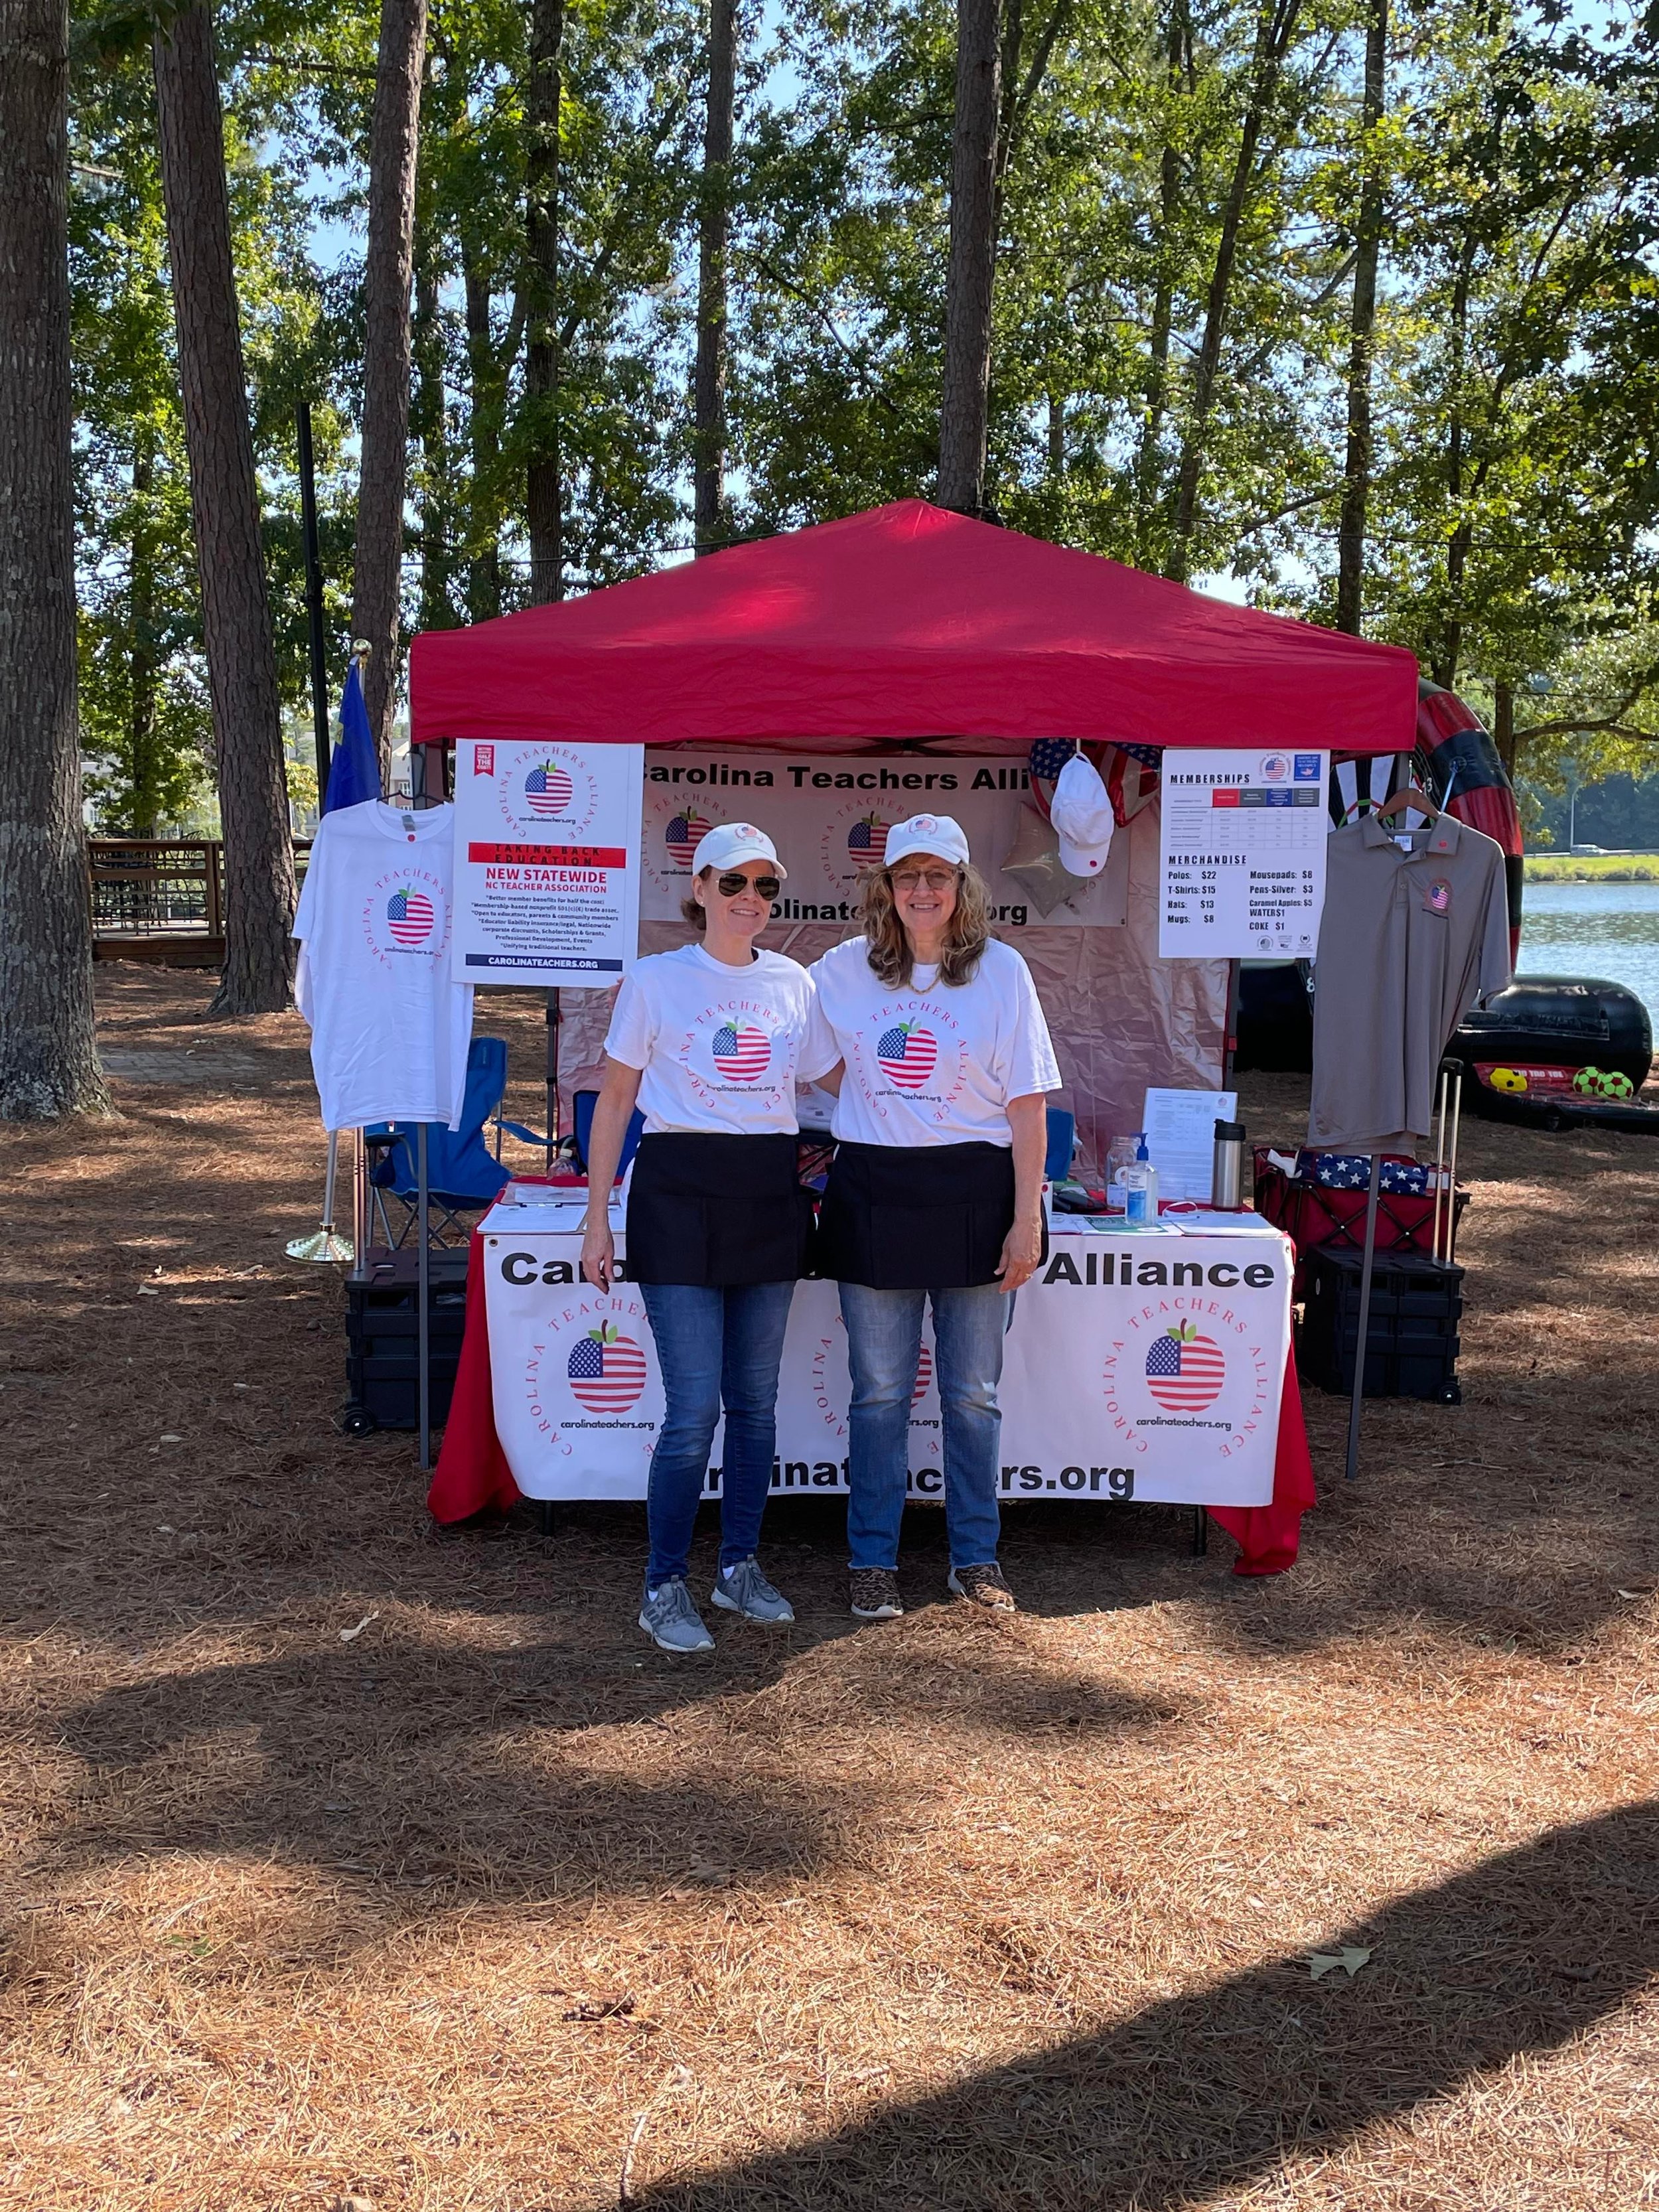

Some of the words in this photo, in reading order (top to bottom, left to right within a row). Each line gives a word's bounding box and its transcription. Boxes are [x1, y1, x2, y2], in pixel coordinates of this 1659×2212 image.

[787, 766, 958, 790] Teachers
[1170, 774, 1250, 784] MEMBERSHIPS
[499, 770, 526, 838] CAROLINA
[514, 745, 586, 769] TEACHERS
[568, 774, 599, 840] ALLIANCE
[654, 792, 728, 817] TEACHERS
[495, 844, 552, 855] TAKING
[561, 846, 601, 856] BACK
[494, 854, 593, 866] EDUCATION
[1169, 855, 1247, 865] MERCHANDISE
[375, 867, 446, 895] TEACHERS
[486, 867, 520, 880] NEW
[524, 869, 607, 883] STATEWIDE
[1168, 871, 1192, 880] Polos:
[1201, 870, 1216, 880] $22
[1250, 870, 1297, 880] Mousepads:
[1302, 870, 1313, 879] $8
[500, 882, 543, 891] TEACHER
[544, 883, 607, 893] ASSOCIATION
[1168, 885, 1200, 894] T-Shirts:
[1202, 885, 1216, 895] $15
[1250, 885, 1297, 894] Pens-Silver:
[1303, 885, 1313, 894] $3
[1167, 900, 1187, 909] Hats:
[1200, 900, 1214, 909] $13
[1303, 899, 1313, 907] $5
[1167, 915, 1191, 924] Mugs:
[1204, 915, 1214, 924] $8
[1249, 922, 1269, 930] COKE
[1275, 921, 1285, 931] $1
[488, 956, 599, 969] CAROLINATEACHERS.ORG
[695, 1000, 780, 1025] TEACHERS
[870, 1001, 960, 1029] TEACHERS
[933, 1039, 969, 1122] ALLIANCE
[1042, 1252, 1275, 1289] Alliance
[548, 1297, 648, 1333] TEACHE
[1103, 1339, 1149, 1453] CAROLINA
[1127, 1297, 1248, 1334] TEACHERS
[1218, 1345, 1269, 1459] ALLIANCE
[813, 1337, 848, 1439] AROLINA
[526, 1343, 573, 1456] CAROLINA
[560, 1418, 655, 1431] carolinateachers.org
[1135, 1416, 1232, 1431] carolinateachers.org
